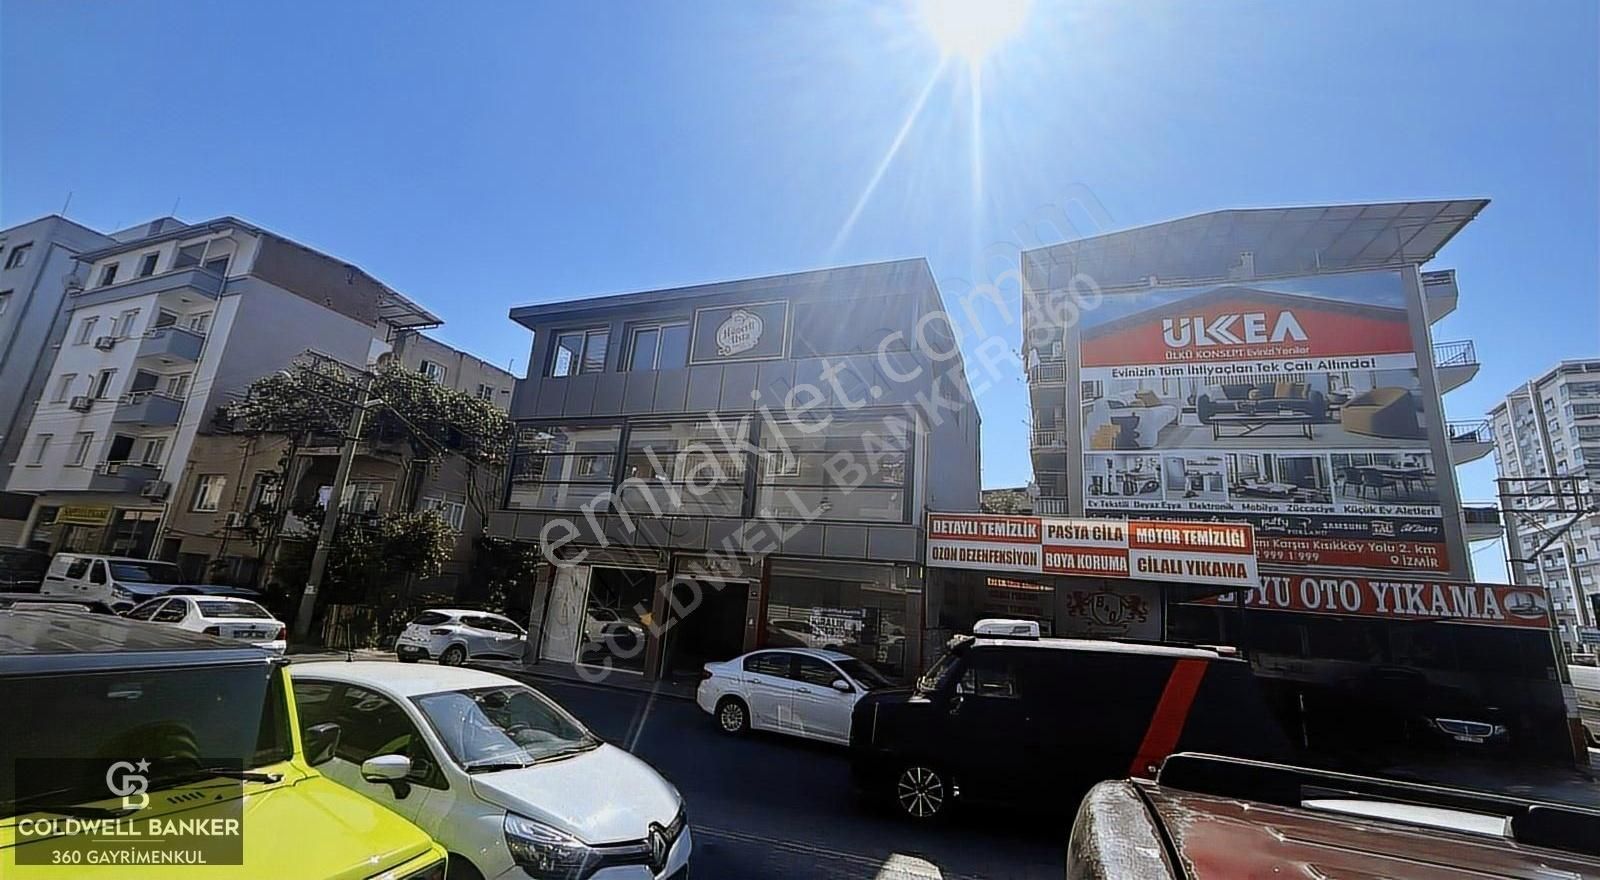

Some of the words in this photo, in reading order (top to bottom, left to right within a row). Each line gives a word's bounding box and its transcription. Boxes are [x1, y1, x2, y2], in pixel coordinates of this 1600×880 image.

[1165, 349, 1193, 361] ÜLKÜ
[1195, 347, 1243, 360] KONSEPT
[1111, 366, 1155, 378] Evinizin
[1158, 364, 1184, 377] Tüm
[1255, 361, 1280, 373] Tek
[1283, 359, 1313, 373] Çatı
[1317, 357, 1376, 371] Altında!
[1188, 501, 1235, 512] Elektronik
[1241, 502, 1279, 514] Mobilya
[1286, 503, 1335, 514] Züccaciye
[1343, 503, 1375, 516] Küçük
[1378, 506, 1392, 515] Ev
[1394, 505, 1435, 516] Aletleri
[933, 520, 978, 535] DETAYLI
[981, 520, 1037, 538] TEMİZLİK
[1048, 523, 1089, 540] PASTA
[1092, 523, 1123, 542] CİLA
[1322, 521, 1369, 530] SAMSUNG
[1136, 528, 1180, 544] MOTOR
[1181, 528, 1246, 548] TEMİZLİĞİ
[932, 546, 957, 561] OZON
[1272, 538, 1309, 551] Karşısı
[1367, 541, 1396, 553] Yolu
[1412, 543, 1437, 555] km
[1045, 553, 1075, 568] BOYA
[1077, 554, 1128, 572] KORUMA
[1137, 556, 1183, 575] CİLALI
[1186, 560, 1248, 579] YIKAMA
[1401, 554, 1440, 568] İZMİR
[1300, 577, 1361, 612] OTO
[1368, 579, 1505, 620] YIKAMA
